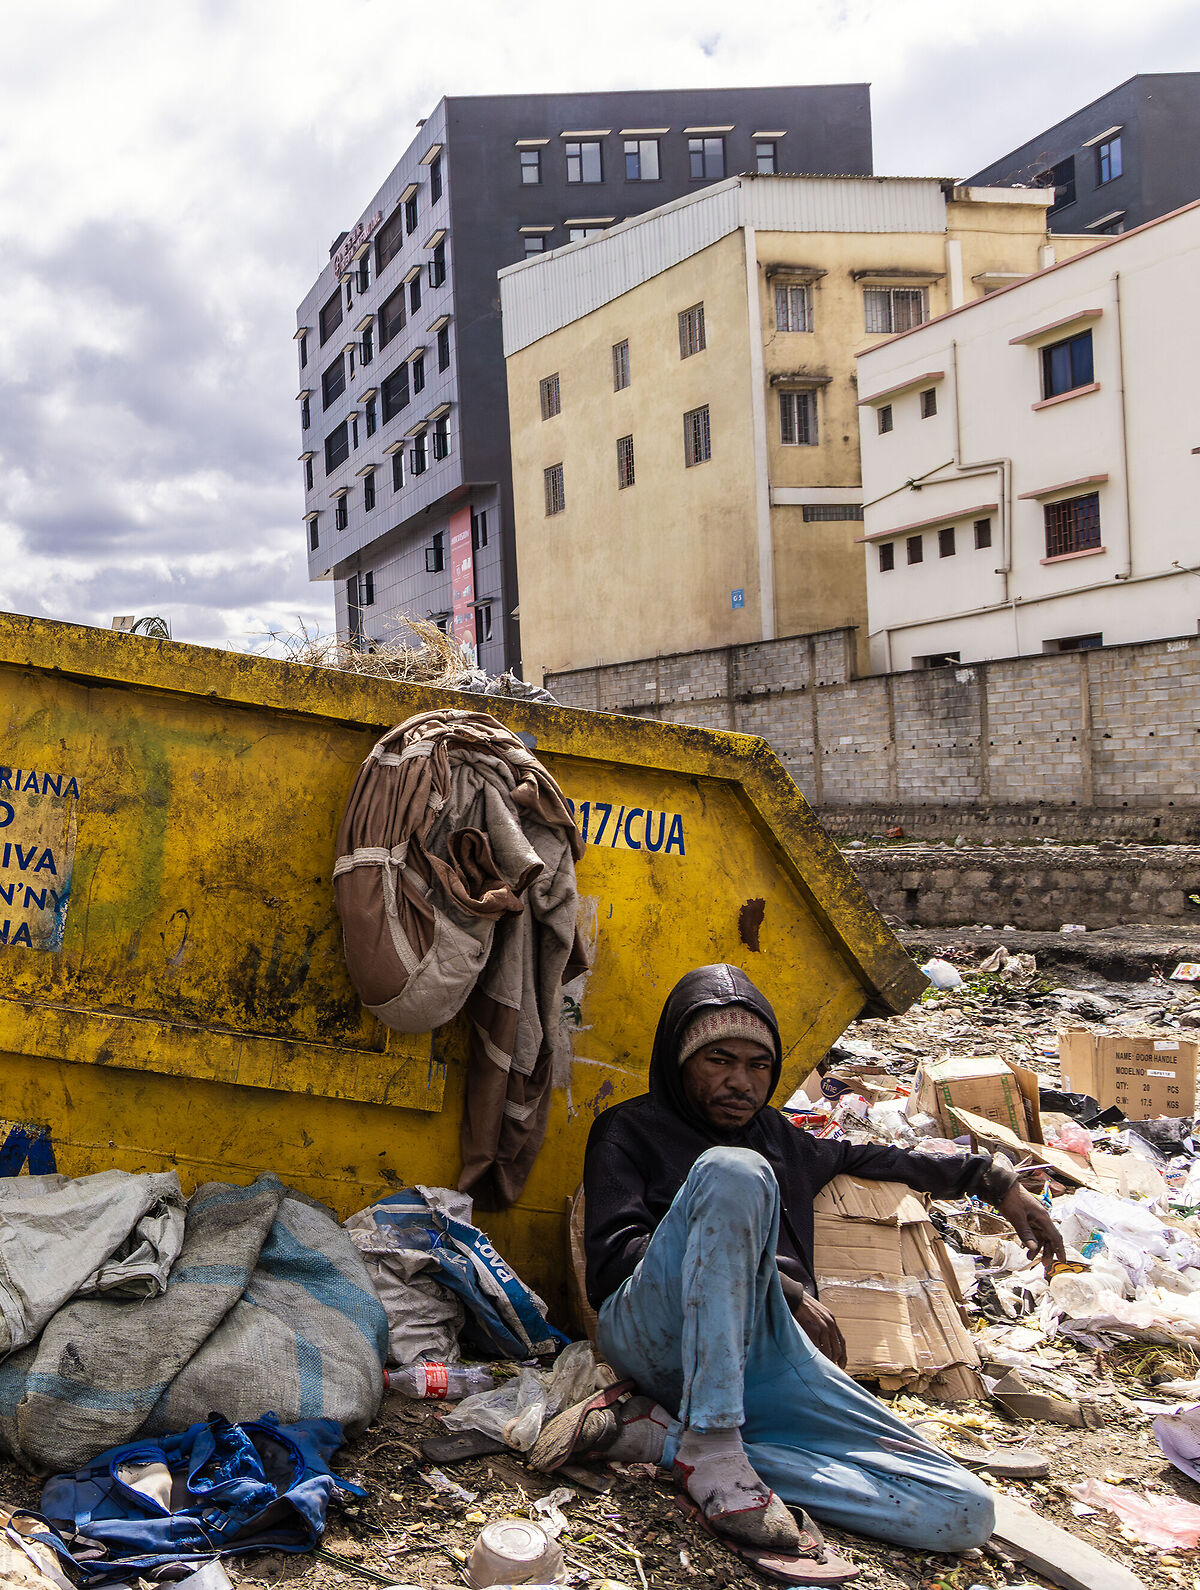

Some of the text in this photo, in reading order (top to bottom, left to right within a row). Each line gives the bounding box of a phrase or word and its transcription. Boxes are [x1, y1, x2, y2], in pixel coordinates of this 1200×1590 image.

[1153, 1055, 1178, 1064] HANDLE
[822, 1079, 838, 1093] Fine
[1115, 1081, 1129, 1090] QTY:
[1167, 1085, 1179, 1094] PCS
[1166, 1100, 1180, 1109] KGS
